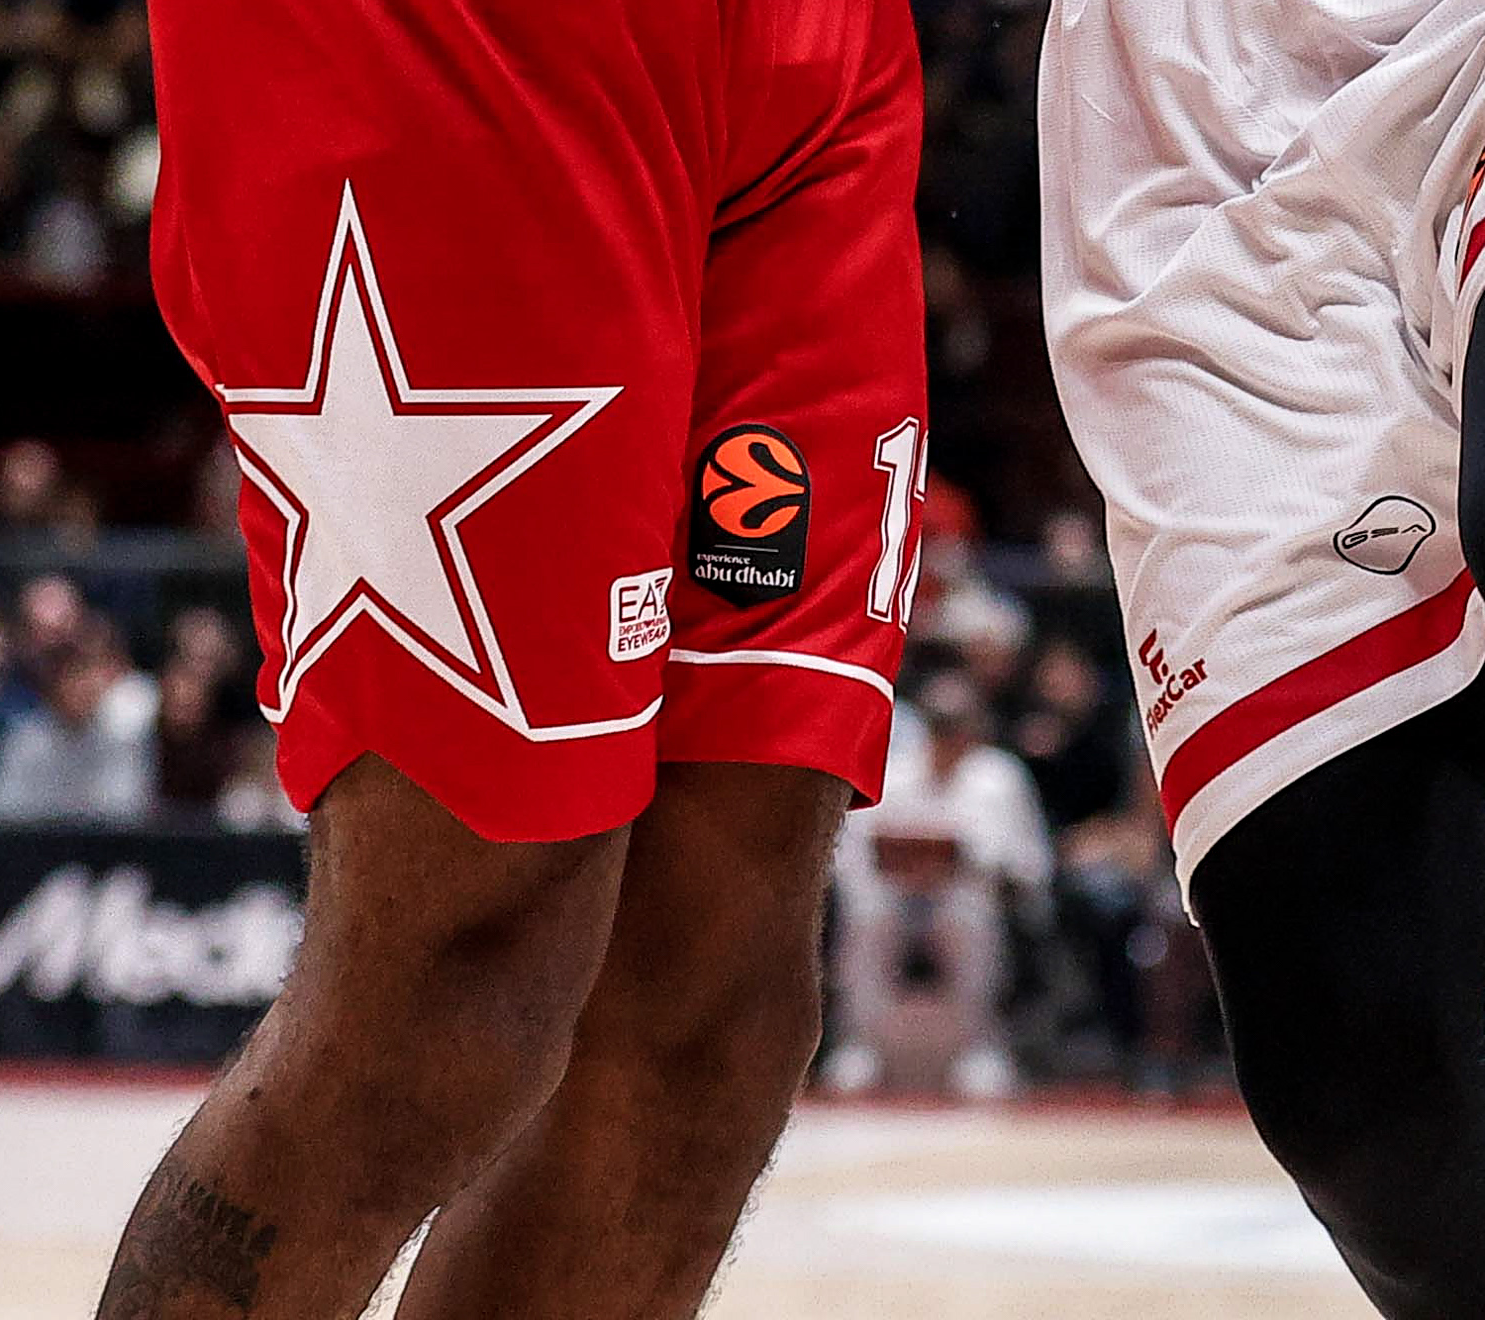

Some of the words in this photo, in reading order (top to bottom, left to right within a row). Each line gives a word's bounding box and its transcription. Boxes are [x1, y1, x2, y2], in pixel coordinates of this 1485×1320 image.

[867, 416, 928, 635] 1
[695, 563, 732, 582] abu
[735, 566, 795, 588] dhabi
[618, 624, 668, 652] EYEWEAR
